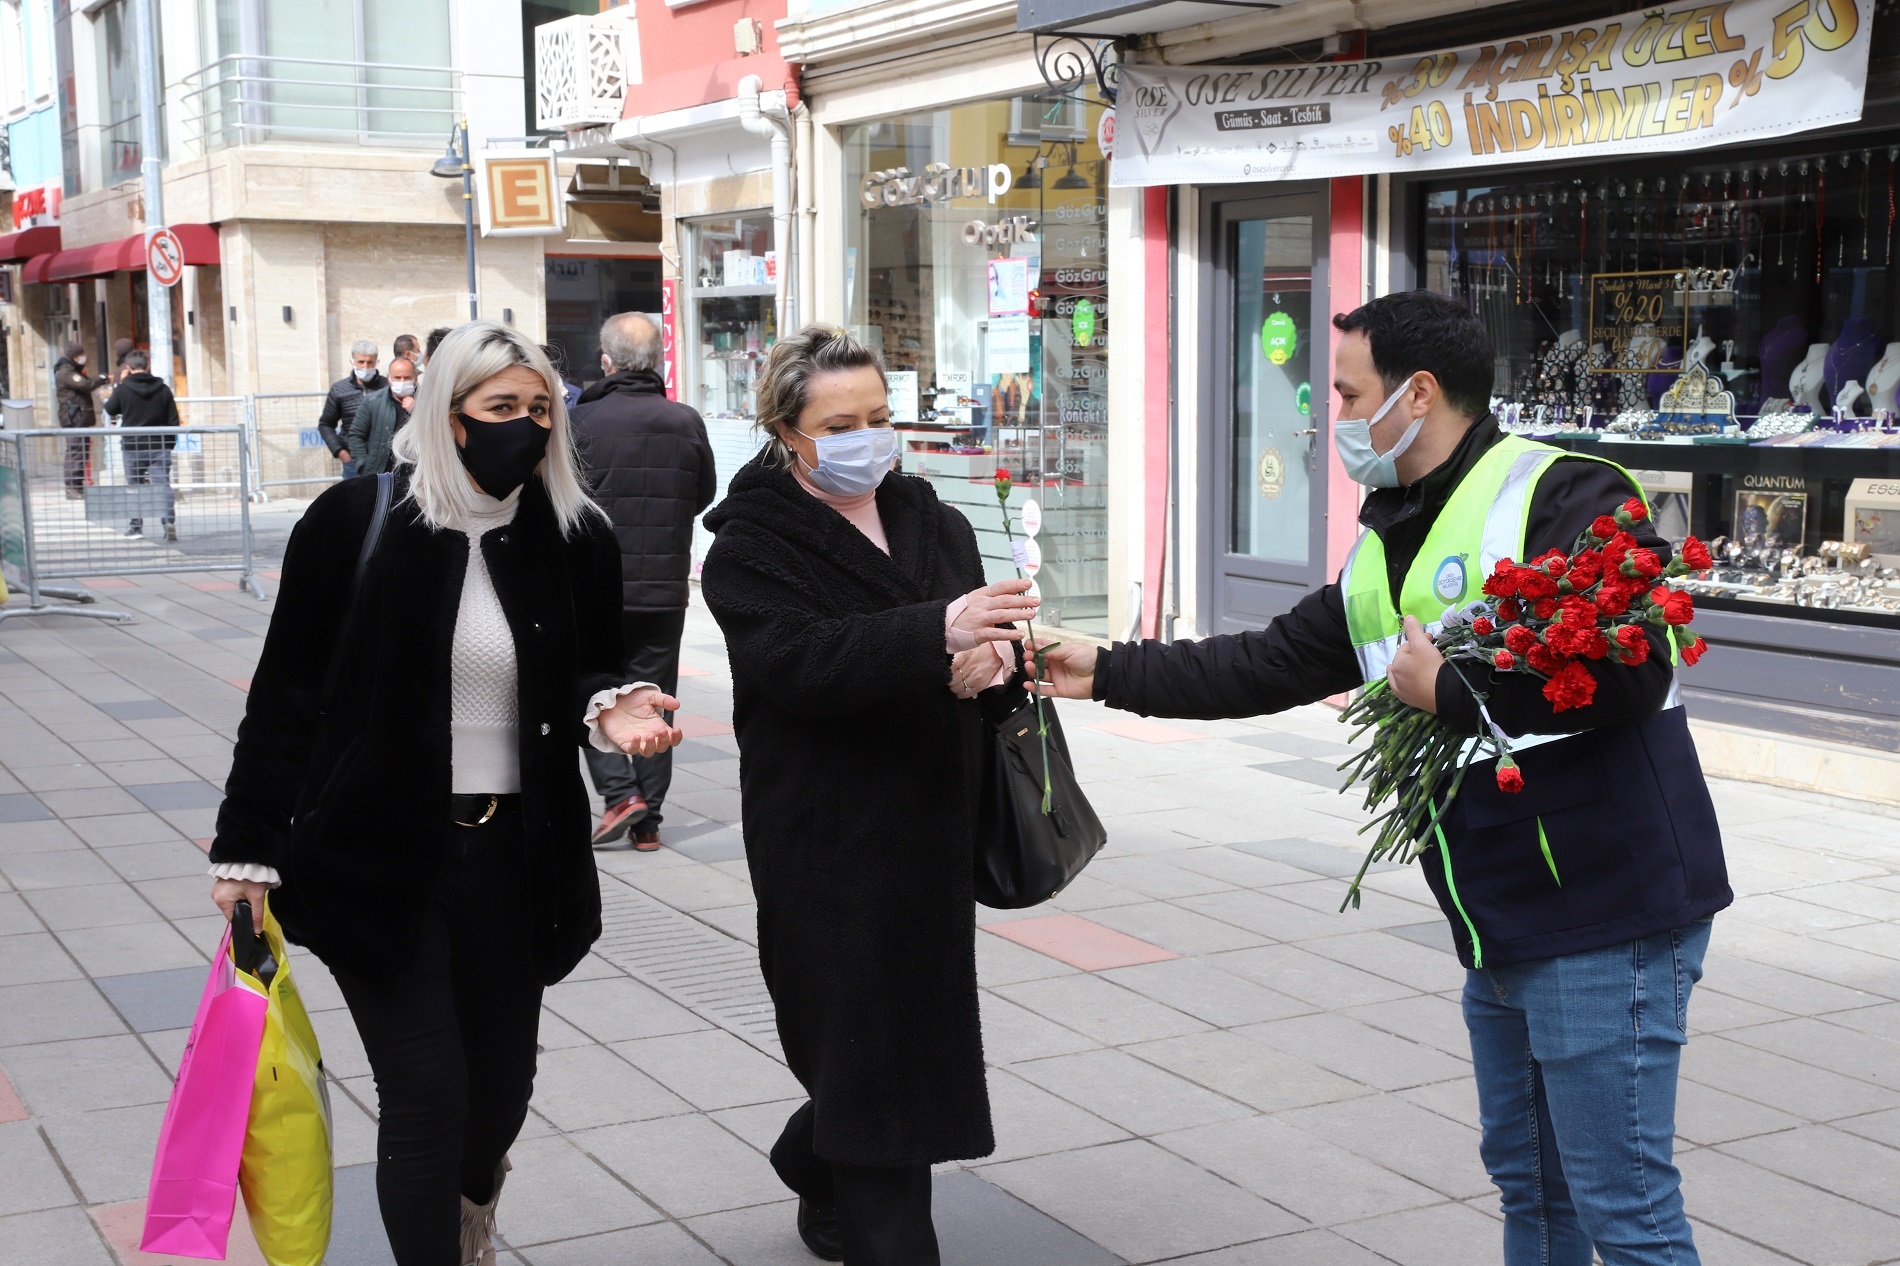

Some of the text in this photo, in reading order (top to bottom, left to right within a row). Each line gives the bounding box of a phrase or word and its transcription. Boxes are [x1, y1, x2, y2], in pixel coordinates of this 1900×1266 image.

[1455, 23, 1621, 101] AÇILIŞA
[1623, 1, 1745, 67] ÖZEL
[1135, 86, 1168, 107] OSE
[1185, 61, 1382, 107] OSE SILVER
[1134, 108, 1167, 118] SILVER
[1260, 109, 1282, 126] Saat
[1290, 106, 1322, 124] Tesbih
[1388, 73, 1724, 158] %40 İNDİRİMLER
[501, 169, 541, 218] E
[860, 162, 1012, 208] GözGrup
[1055, 203, 1108, 219] GözGru
[1615, 291, 1664, 325] %20
[1270, 337, 1287, 347] AÇIK
[1744, 475, 1805, 489] QUANTUM
